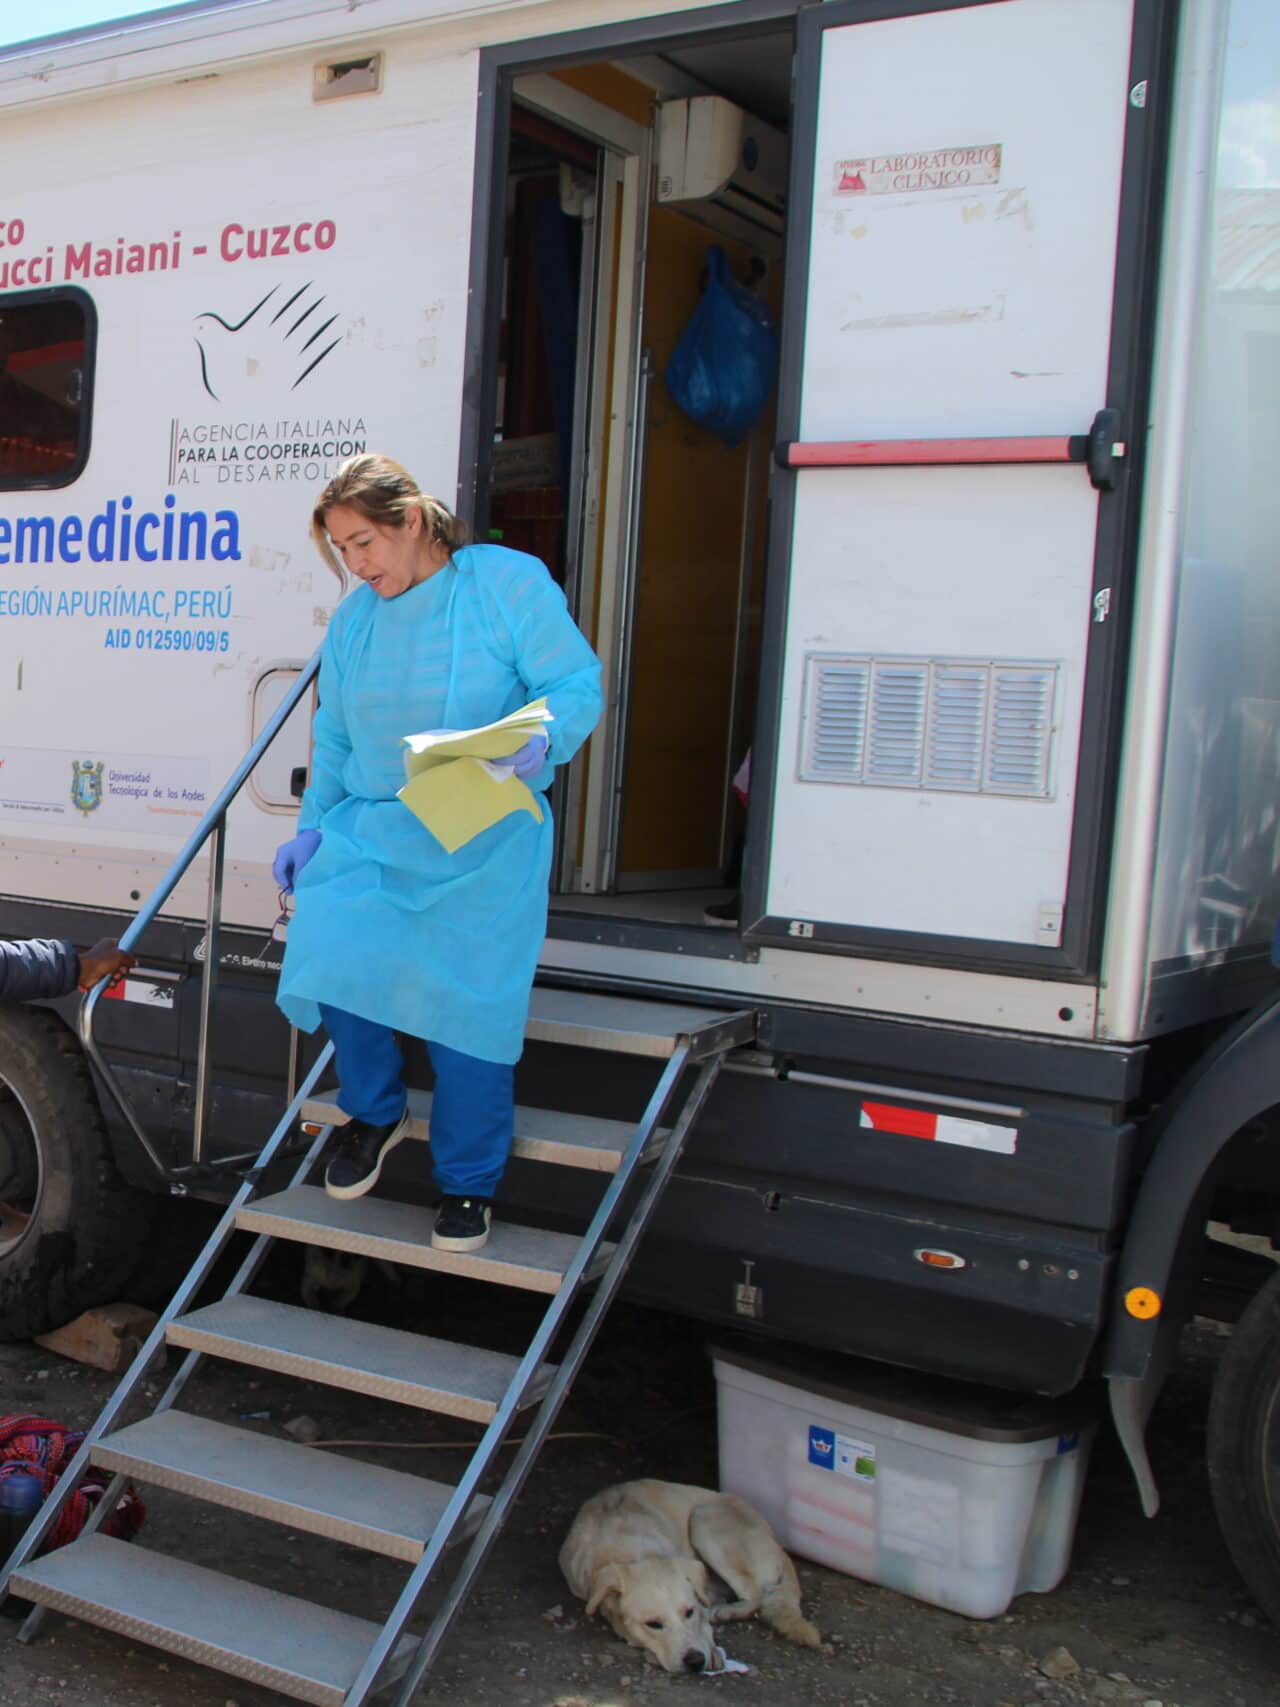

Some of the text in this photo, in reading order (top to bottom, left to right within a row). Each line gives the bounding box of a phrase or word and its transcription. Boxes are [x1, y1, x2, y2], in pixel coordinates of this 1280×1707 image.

[870, 149, 997, 175] LABORATORIO
[892, 169, 970, 191] CLÍNICO
[63, 230, 182, 280] Maiani
[220, 218, 337, 263] Cuzco
[178, 416, 367, 444] AGENCIA ITALIANA
[177, 440, 367, 463] PARA LA COOPERACION
[177, 461, 339, 485] AL DESARROL
[56, 583, 172, 624] APURÍMAC,
[173, 584, 233, 619] PERÚ
[104, 628, 231, 652] AID 012590/09/5
[109, 769, 151, 784] Universidad
[153, 788, 163, 798] de
[167, 788, 178, 799] los
[182, 789, 205, 801] Andes
